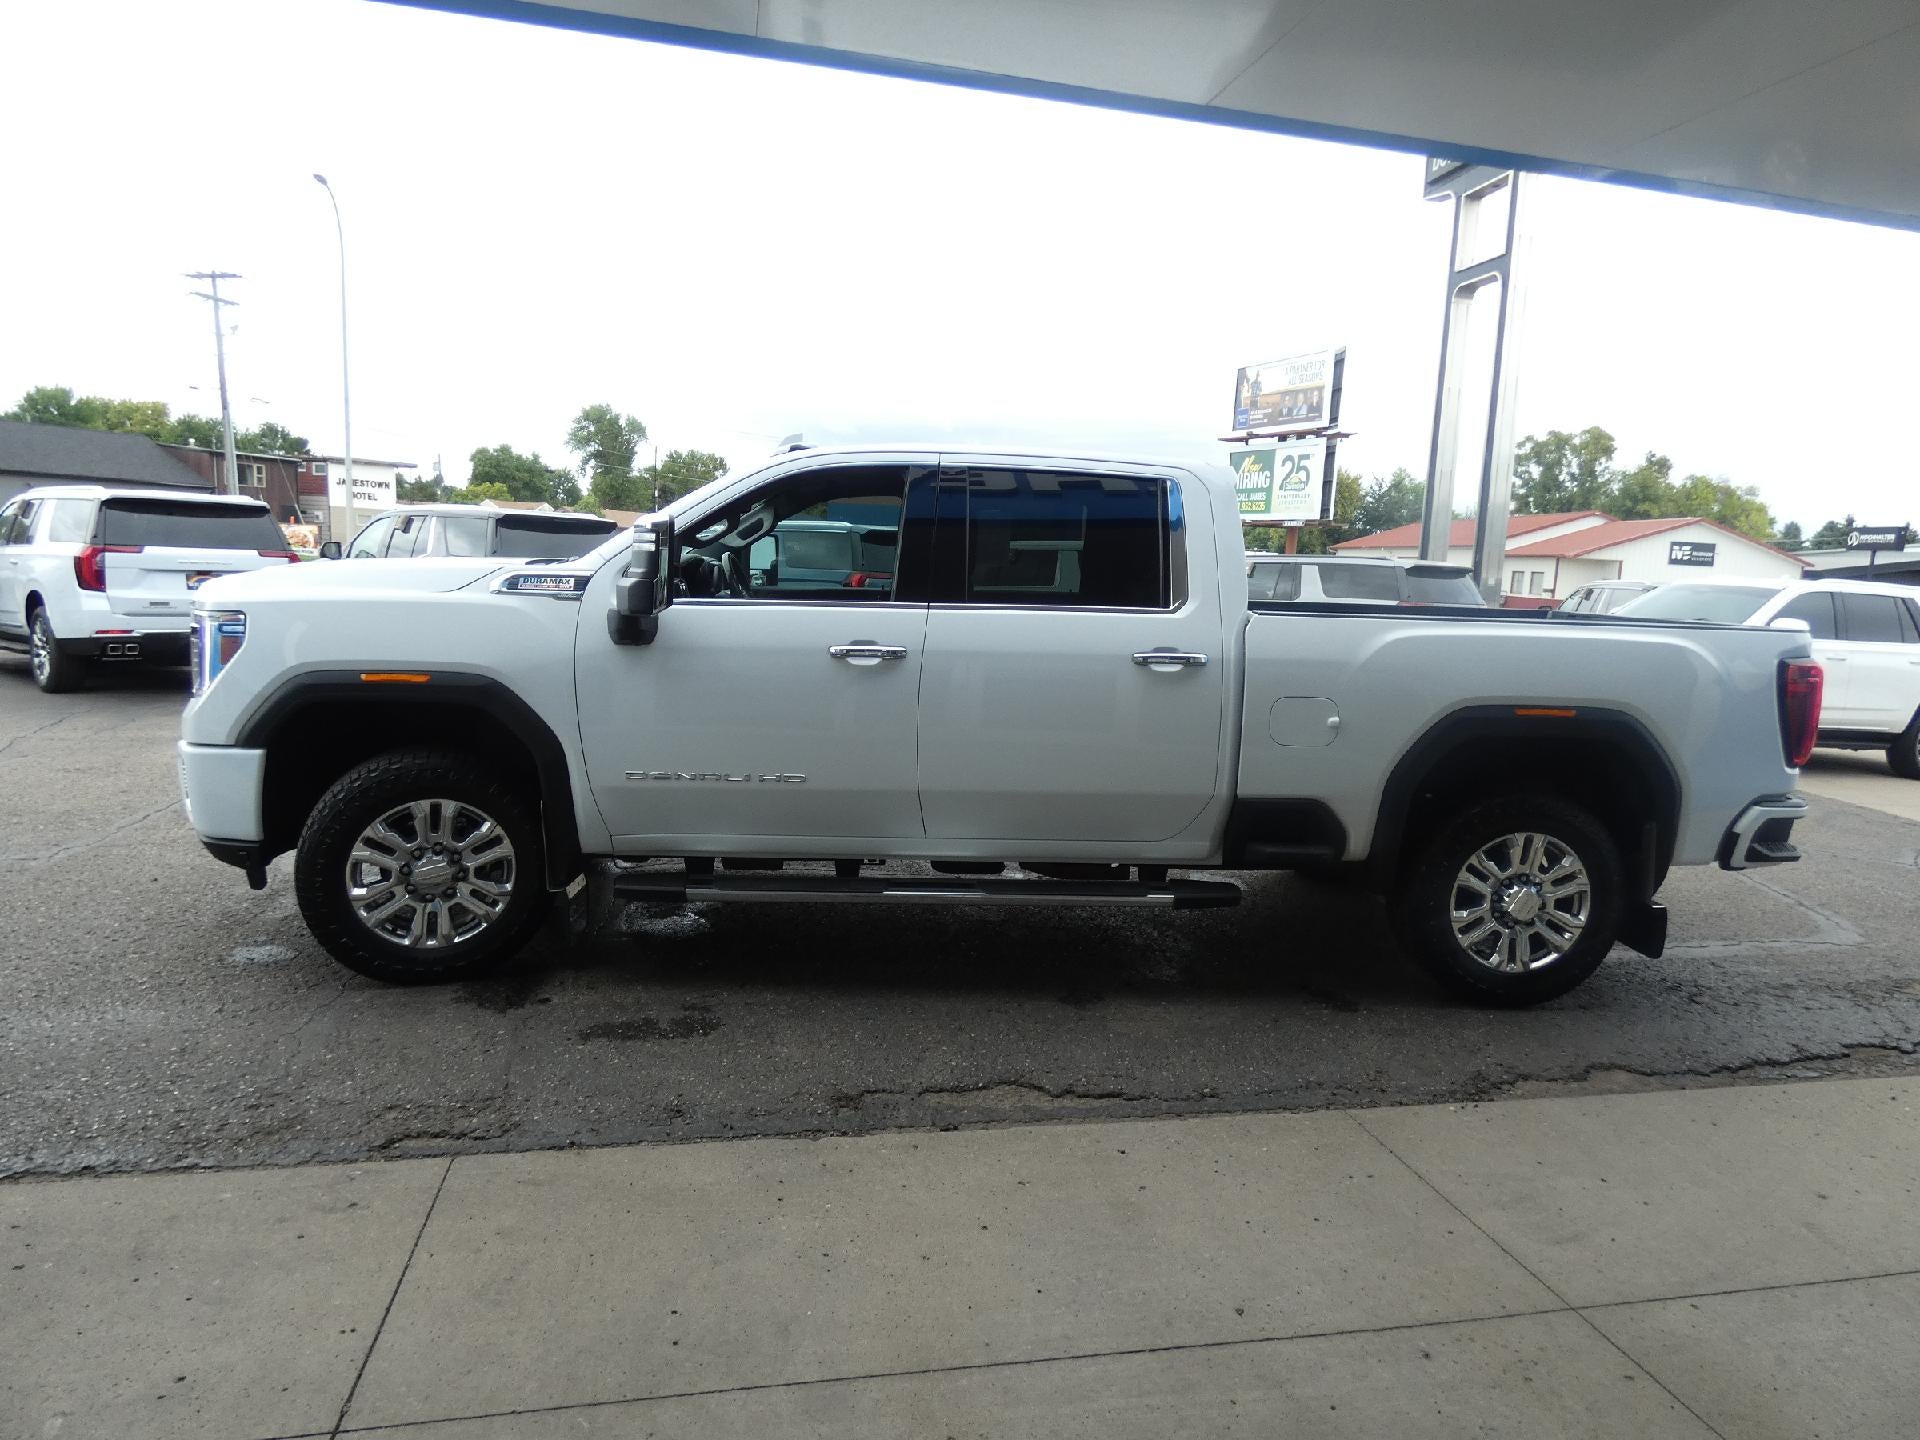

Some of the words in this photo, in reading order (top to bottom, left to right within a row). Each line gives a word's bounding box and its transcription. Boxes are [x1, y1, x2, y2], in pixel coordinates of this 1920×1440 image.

[1279, 454, 1311, 491] 25
[336, 477, 391, 490] JAESTOWN
[522, 577, 571, 585] DURAMAX
[624, 770, 751, 781] DENALI
[758, 773, 807, 783] HD
